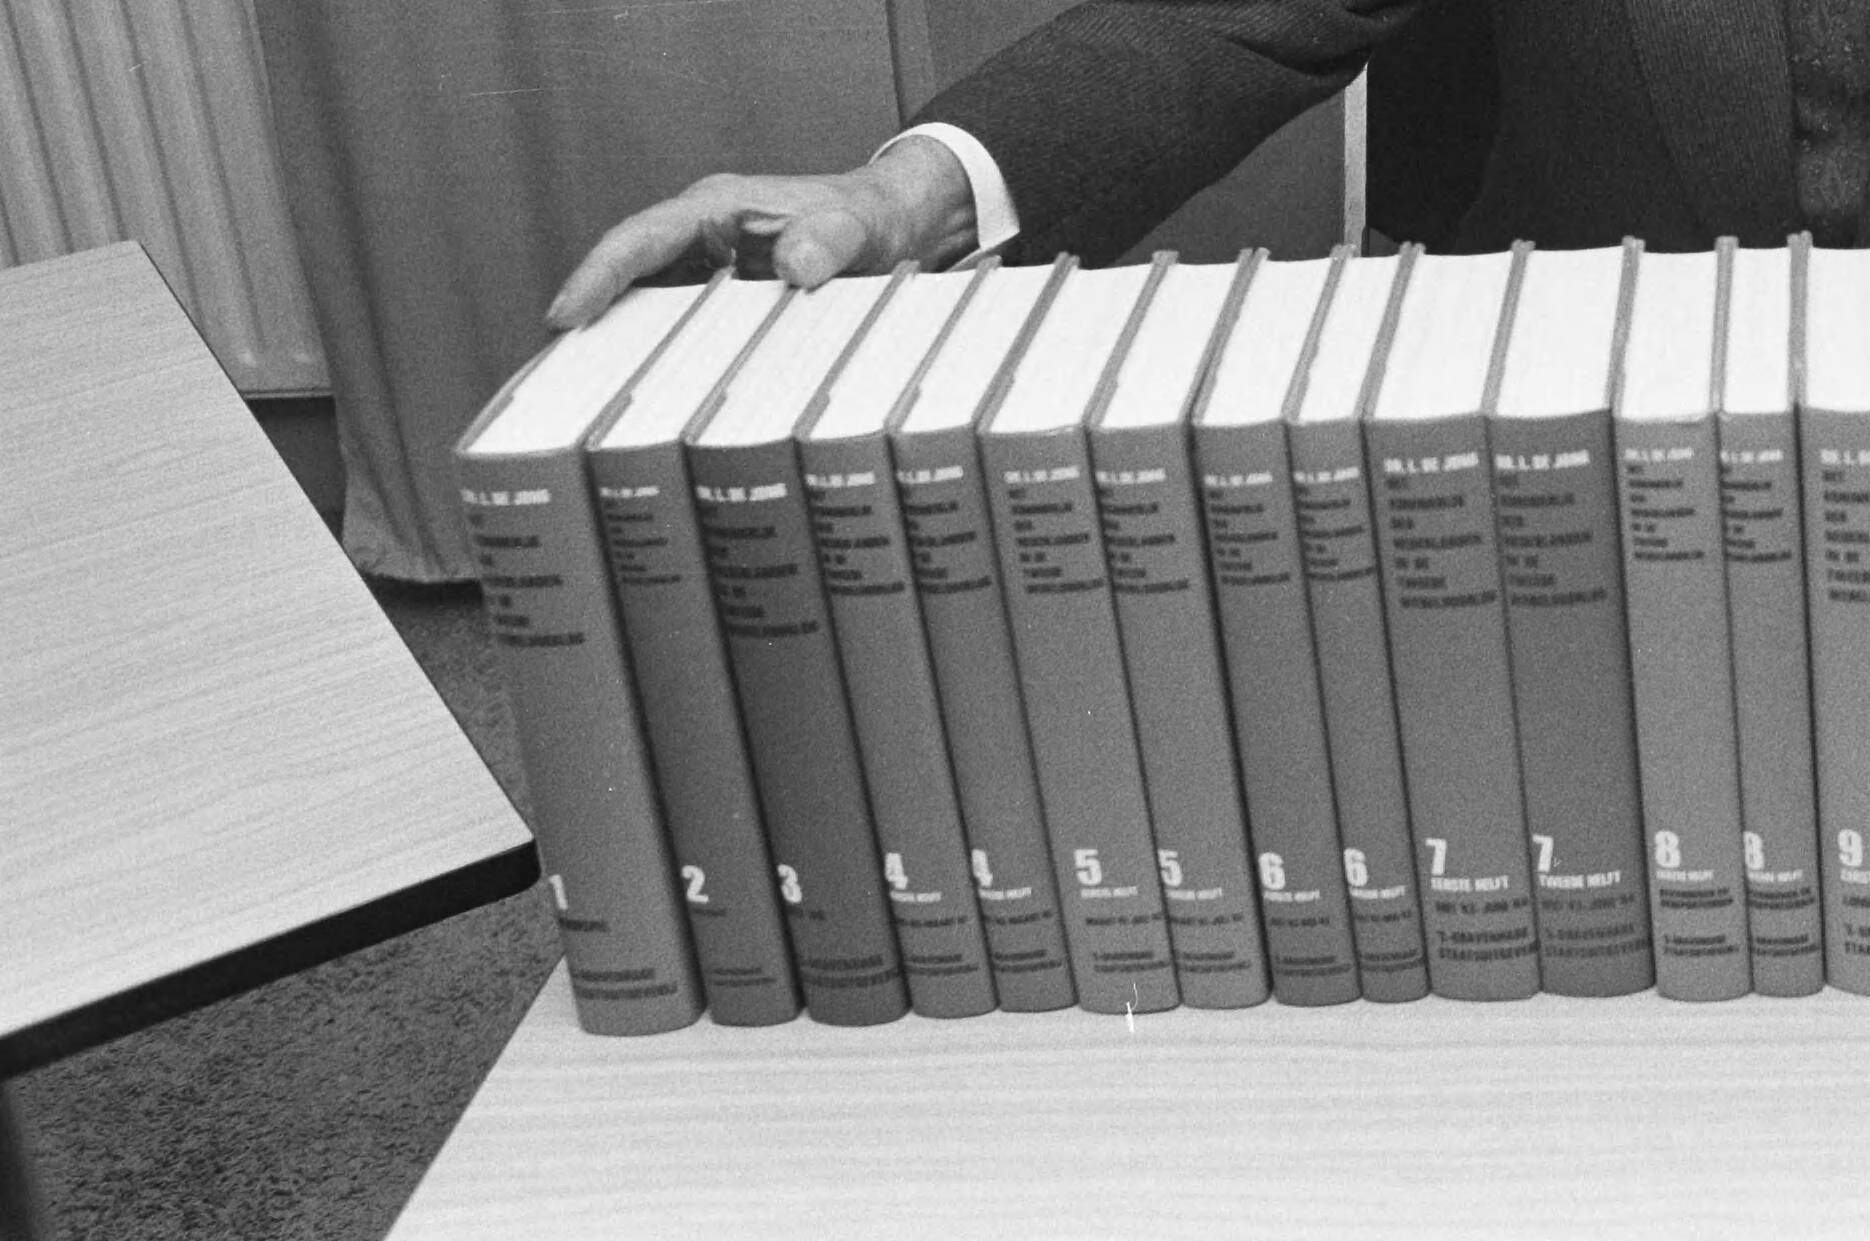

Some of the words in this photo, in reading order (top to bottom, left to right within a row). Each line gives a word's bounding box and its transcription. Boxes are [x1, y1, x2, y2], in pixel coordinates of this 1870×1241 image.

[1425, 838, 1447, 876] 7
[1532, 834, 1554, 872] 7
[1654, 830, 1681, 868] 8
[1743, 831, 1765, 870] 8
[1838, 828, 1863, 867] 9
[681, 865, 709, 903] 2
[778, 864, 802, 904] 3
[884, 852, 908, 890] 4
[1074, 849, 1102, 886] 5
[1158, 849, 1183, 887] 5
[1258, 852, 1287, 890] 6
[1344, 848, 1368, 887] 6
